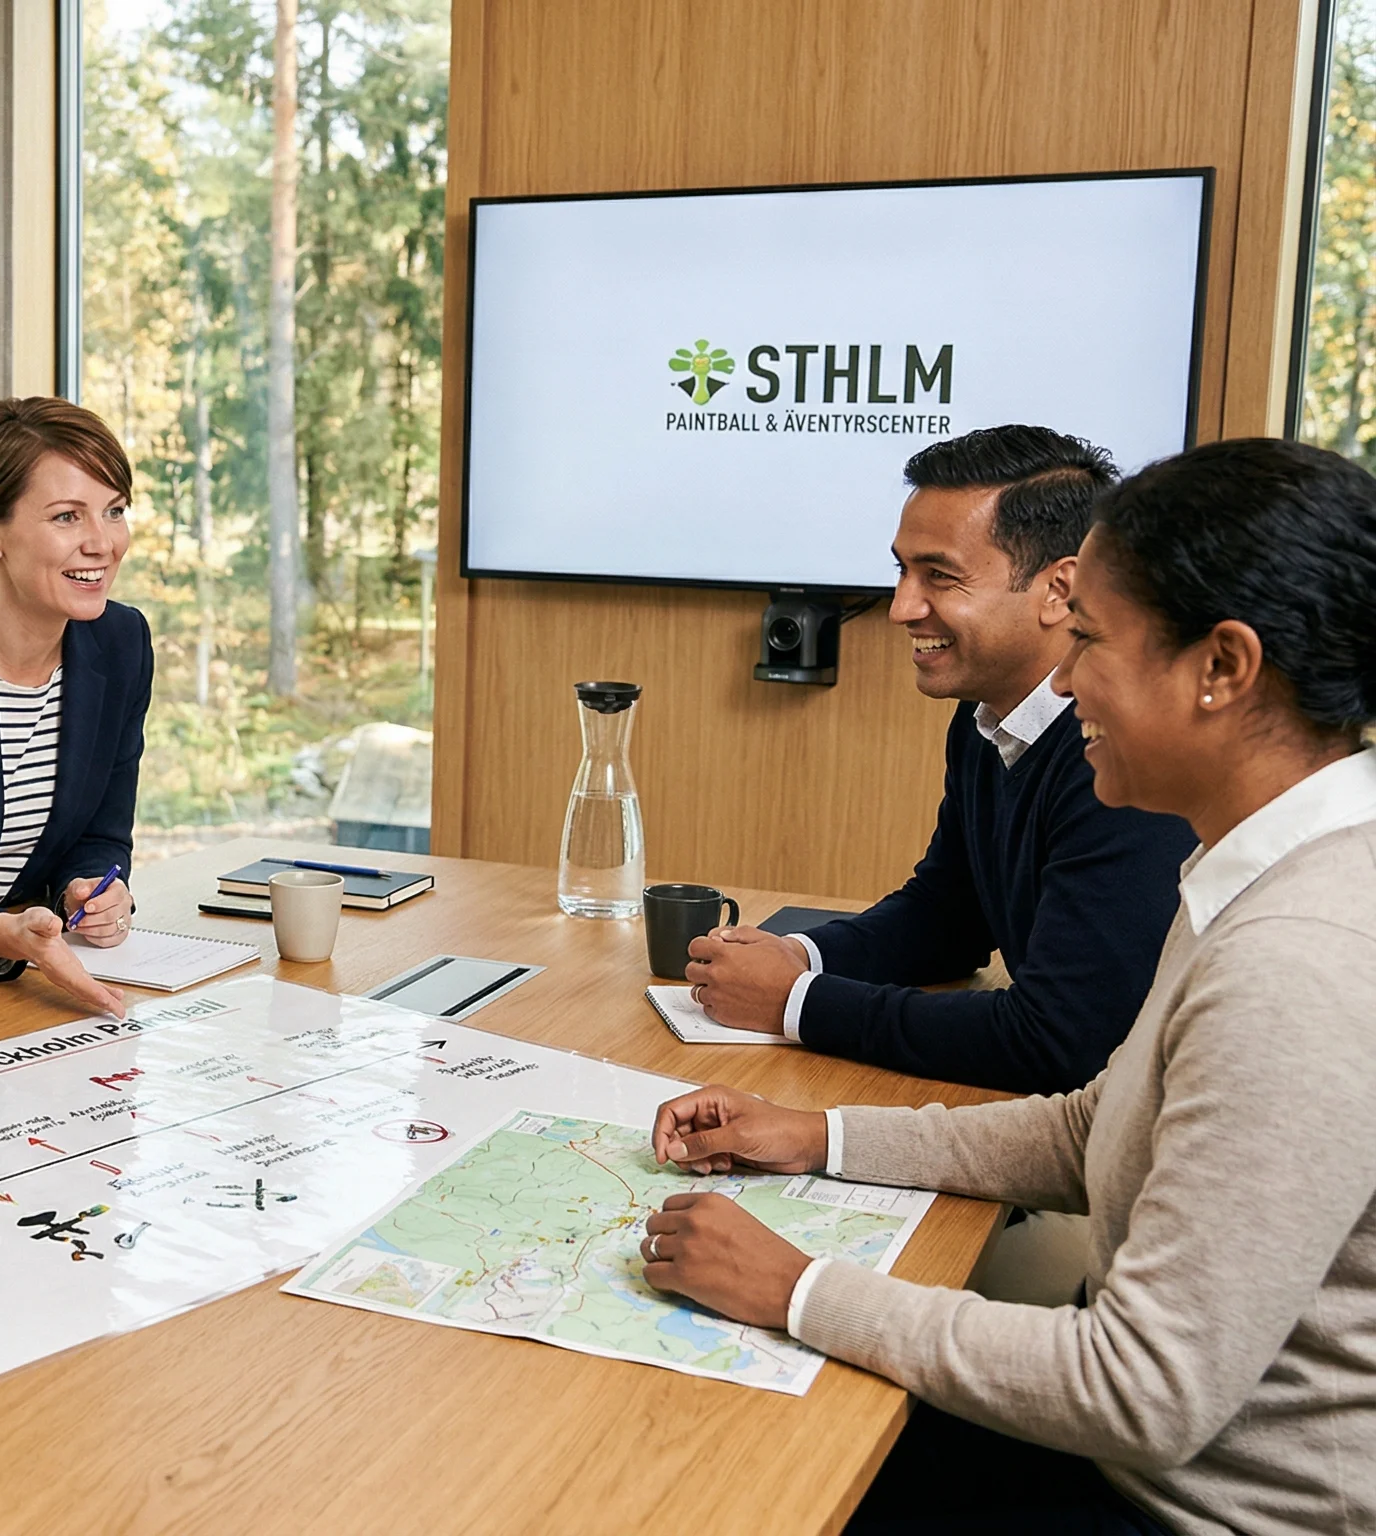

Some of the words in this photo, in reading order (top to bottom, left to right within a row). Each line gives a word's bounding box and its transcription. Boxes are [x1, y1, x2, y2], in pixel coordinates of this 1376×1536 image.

[745, 343, 954, 404] STHLM
[665, 411, 761, 433] PAINTBALL
[765, 412, 778, 433] &
[783, 408, 951, 435] ÄVENTYRSCENTER
